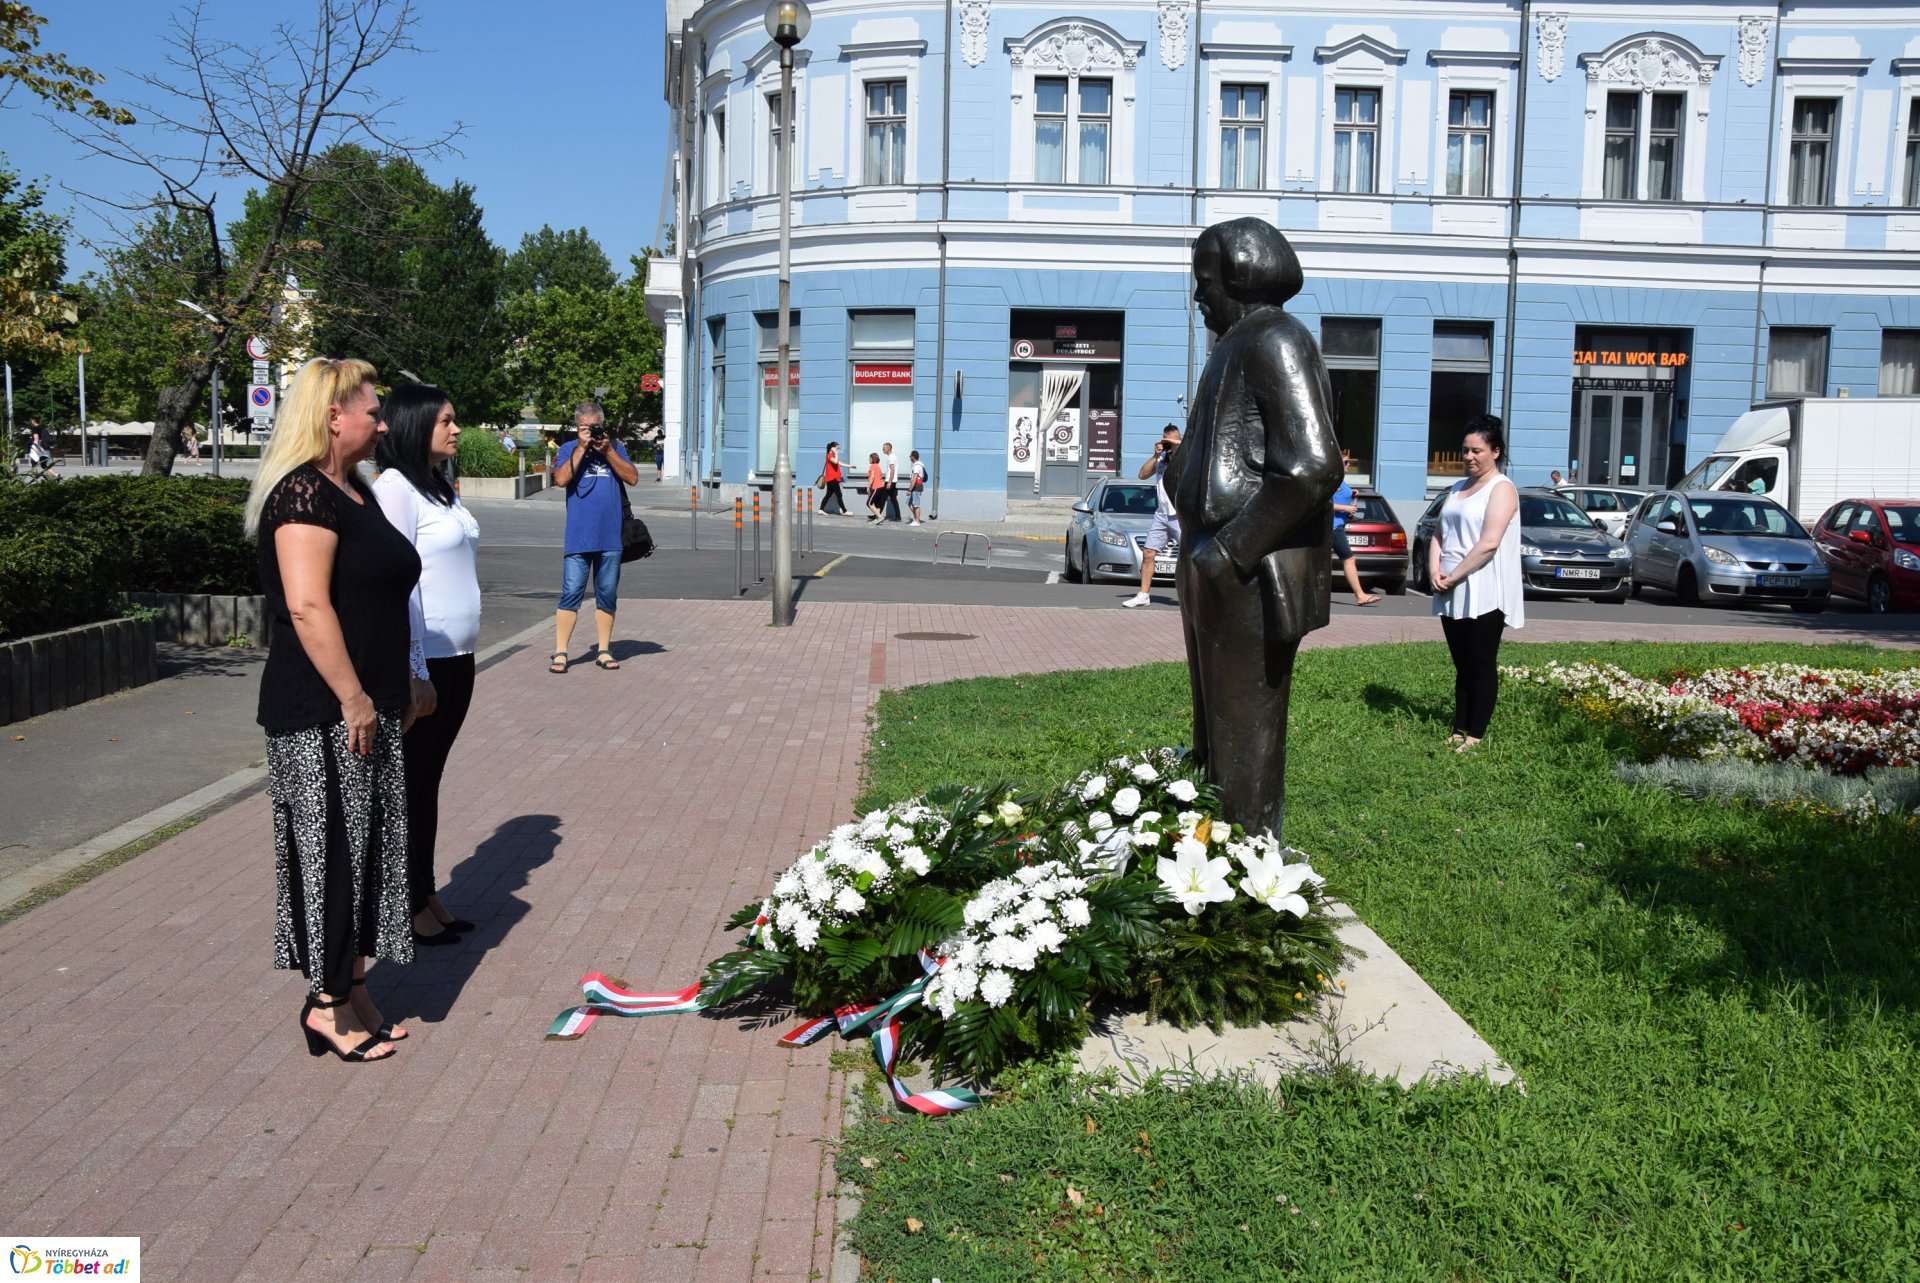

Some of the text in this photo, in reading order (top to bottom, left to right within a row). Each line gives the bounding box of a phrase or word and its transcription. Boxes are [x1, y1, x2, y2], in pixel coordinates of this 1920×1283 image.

[1601, 352, 1621, 365] TAI
[1625, 352, 1656, 365] WOK
[1660, 353, 1686, 366] BAR
[855, 370, 912, 378] BUDAPEST BANK
[1562, 569, 1598, 578] NMR-194
